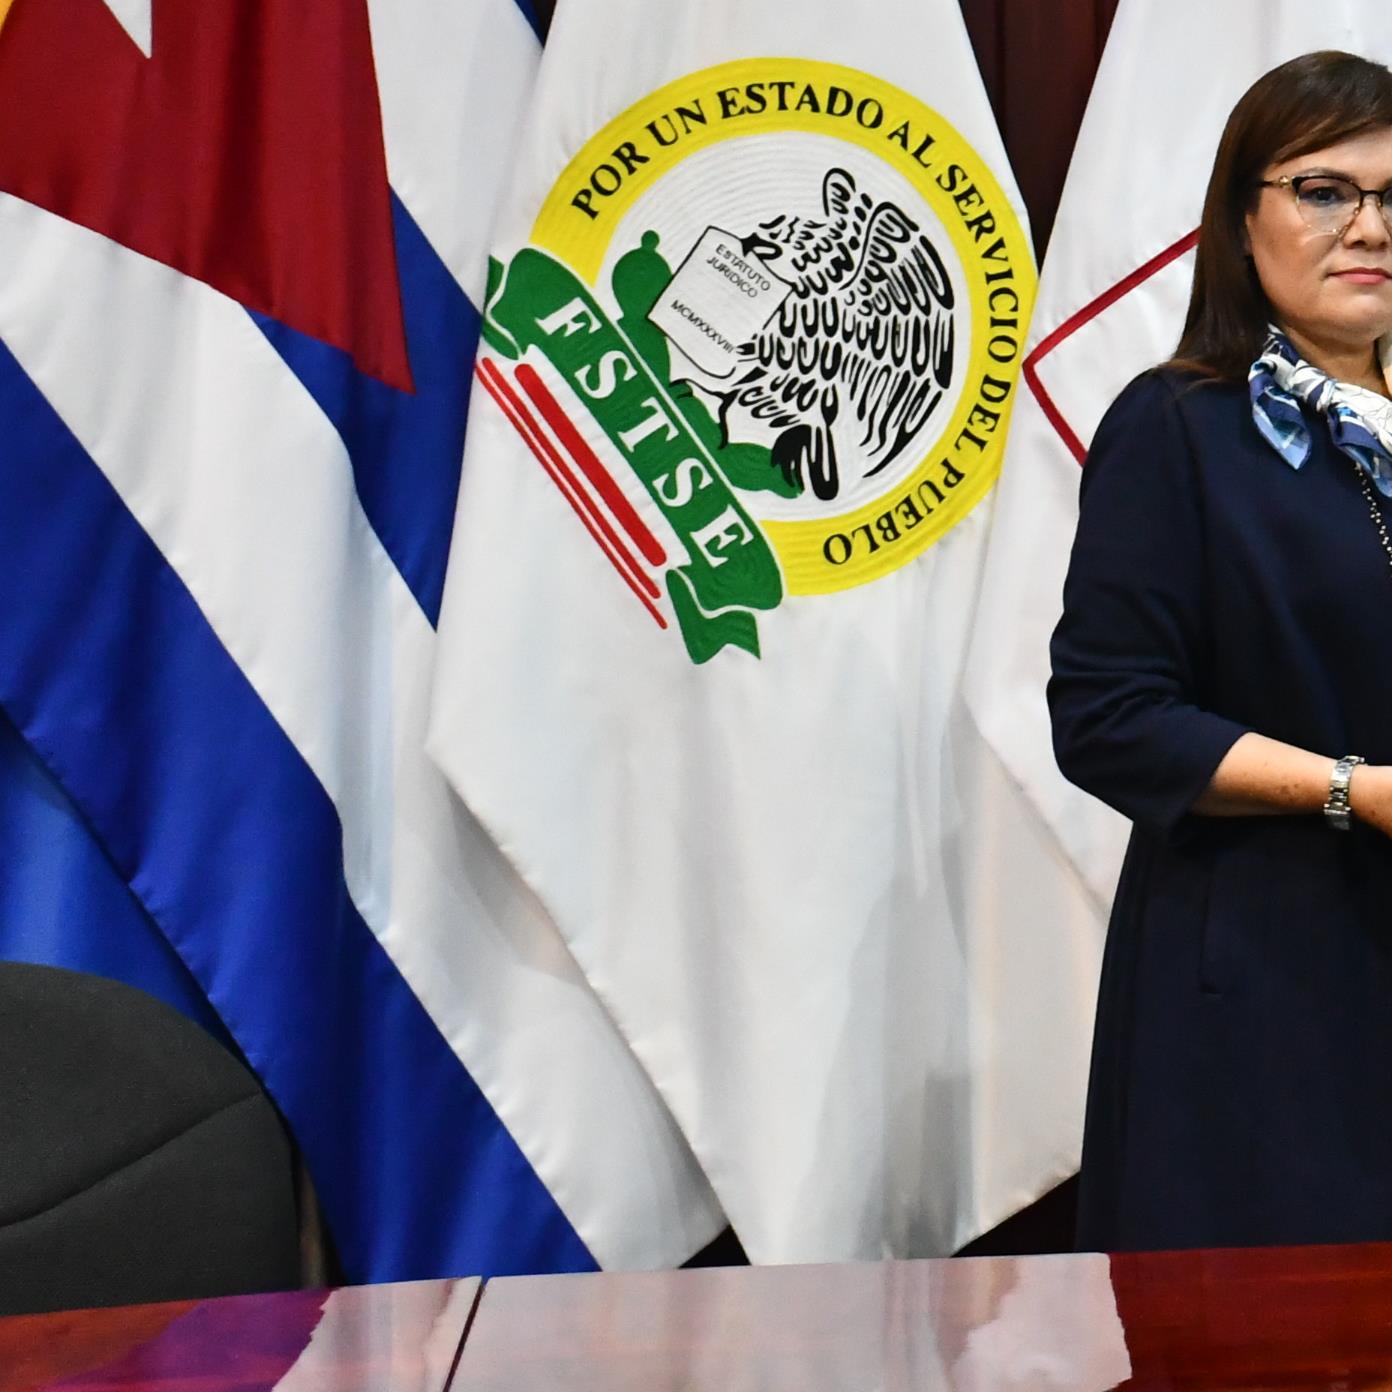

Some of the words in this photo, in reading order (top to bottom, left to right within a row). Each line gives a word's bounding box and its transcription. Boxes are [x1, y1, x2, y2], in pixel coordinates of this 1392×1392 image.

[646, 100, 708, 147] UN
[716, 81, 883, 131] ESTADO
[887, 120, 935, 168] AL
[571, 141, 651, 221] POR
[715, 243, 771, 291] ESTATUTO
[935, 163, 1019, 363] SERVICIO
[536, 297, 754, 567] FSTSE
[955, 373, 1012, 452] DEL
[823, 459, 965, 565] PUEBLO
